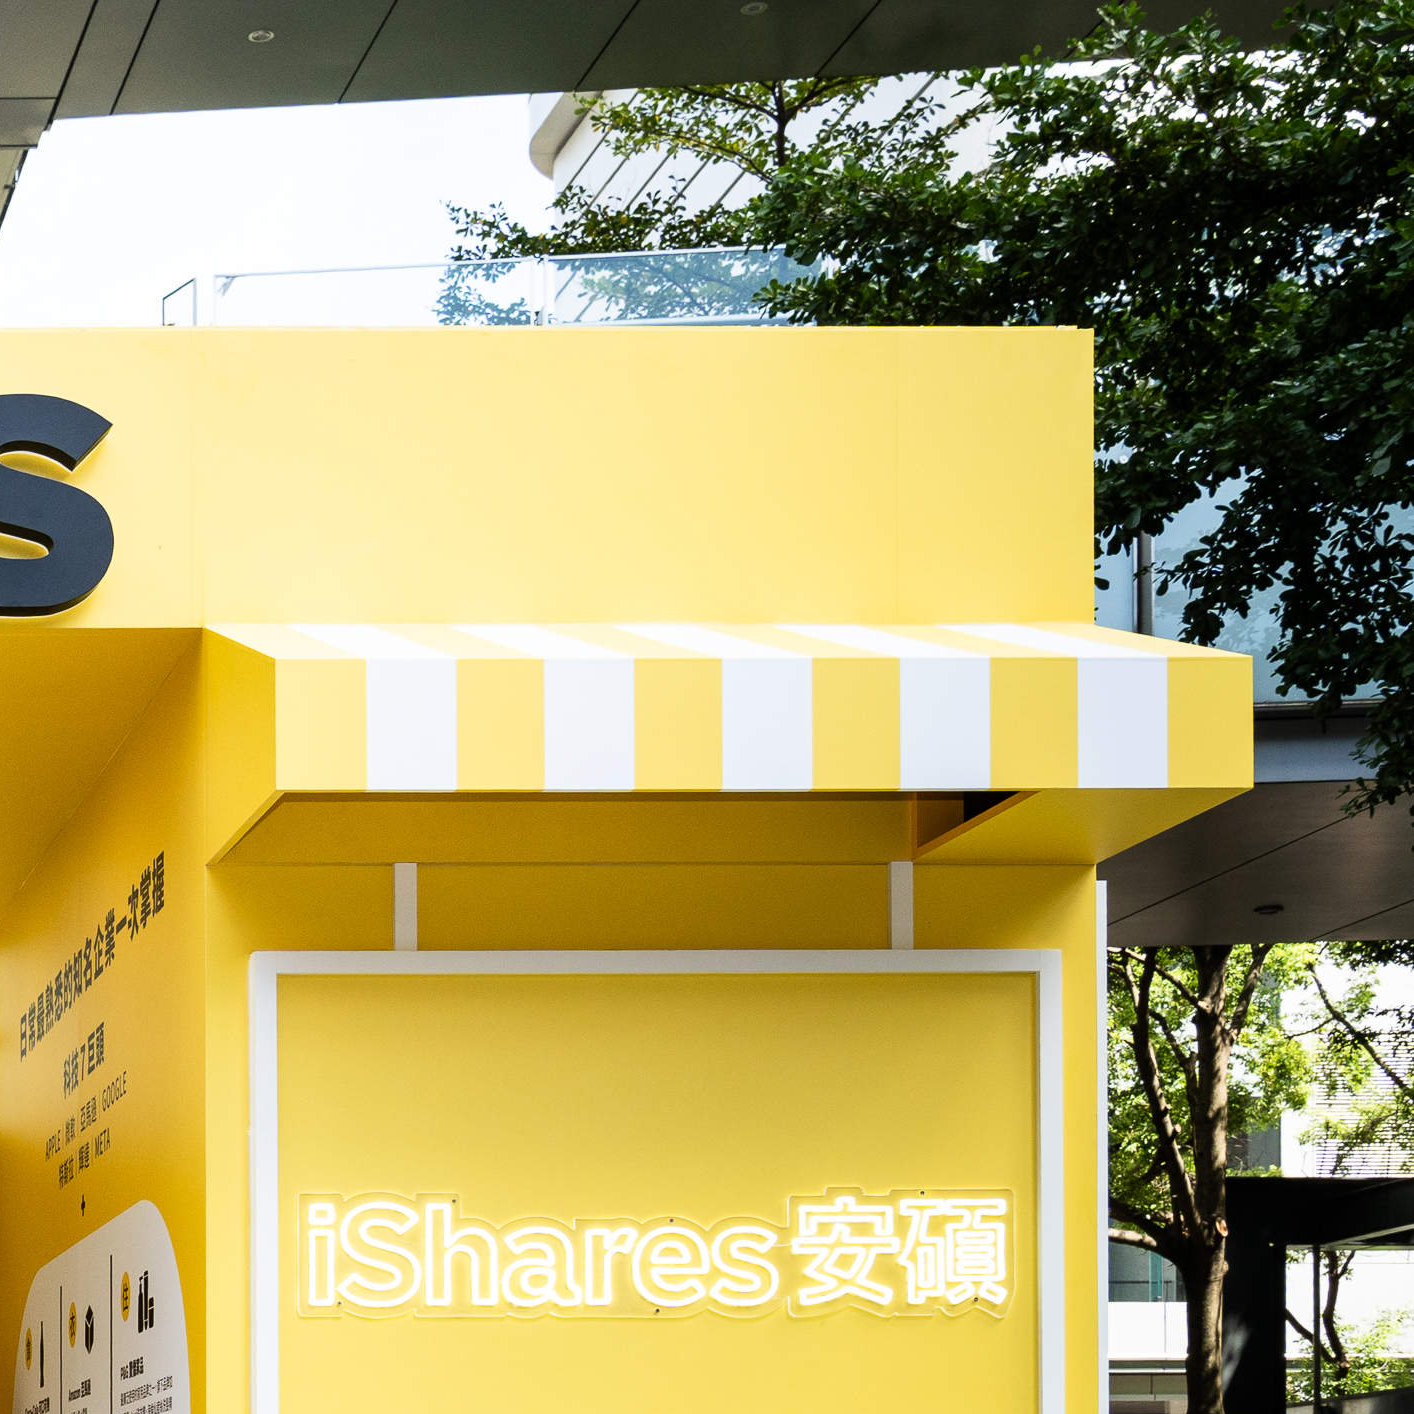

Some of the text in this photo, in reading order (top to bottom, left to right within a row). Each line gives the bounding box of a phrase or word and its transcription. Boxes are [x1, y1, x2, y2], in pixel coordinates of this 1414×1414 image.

[20, 850, 165, 1063] 日常最熟悉的知名企業一次掌握
[63, 1043, 80, 1099] 科技
[88, 1021, 105, 1079] 巨頭
[45, 1130, 61, 1162] APPLE
[101, 1071, 127, 1113] GOOGLE
[94, 1127, 111, 1161] META
[304, 1194, 1012, 1309] iShares 安碩
